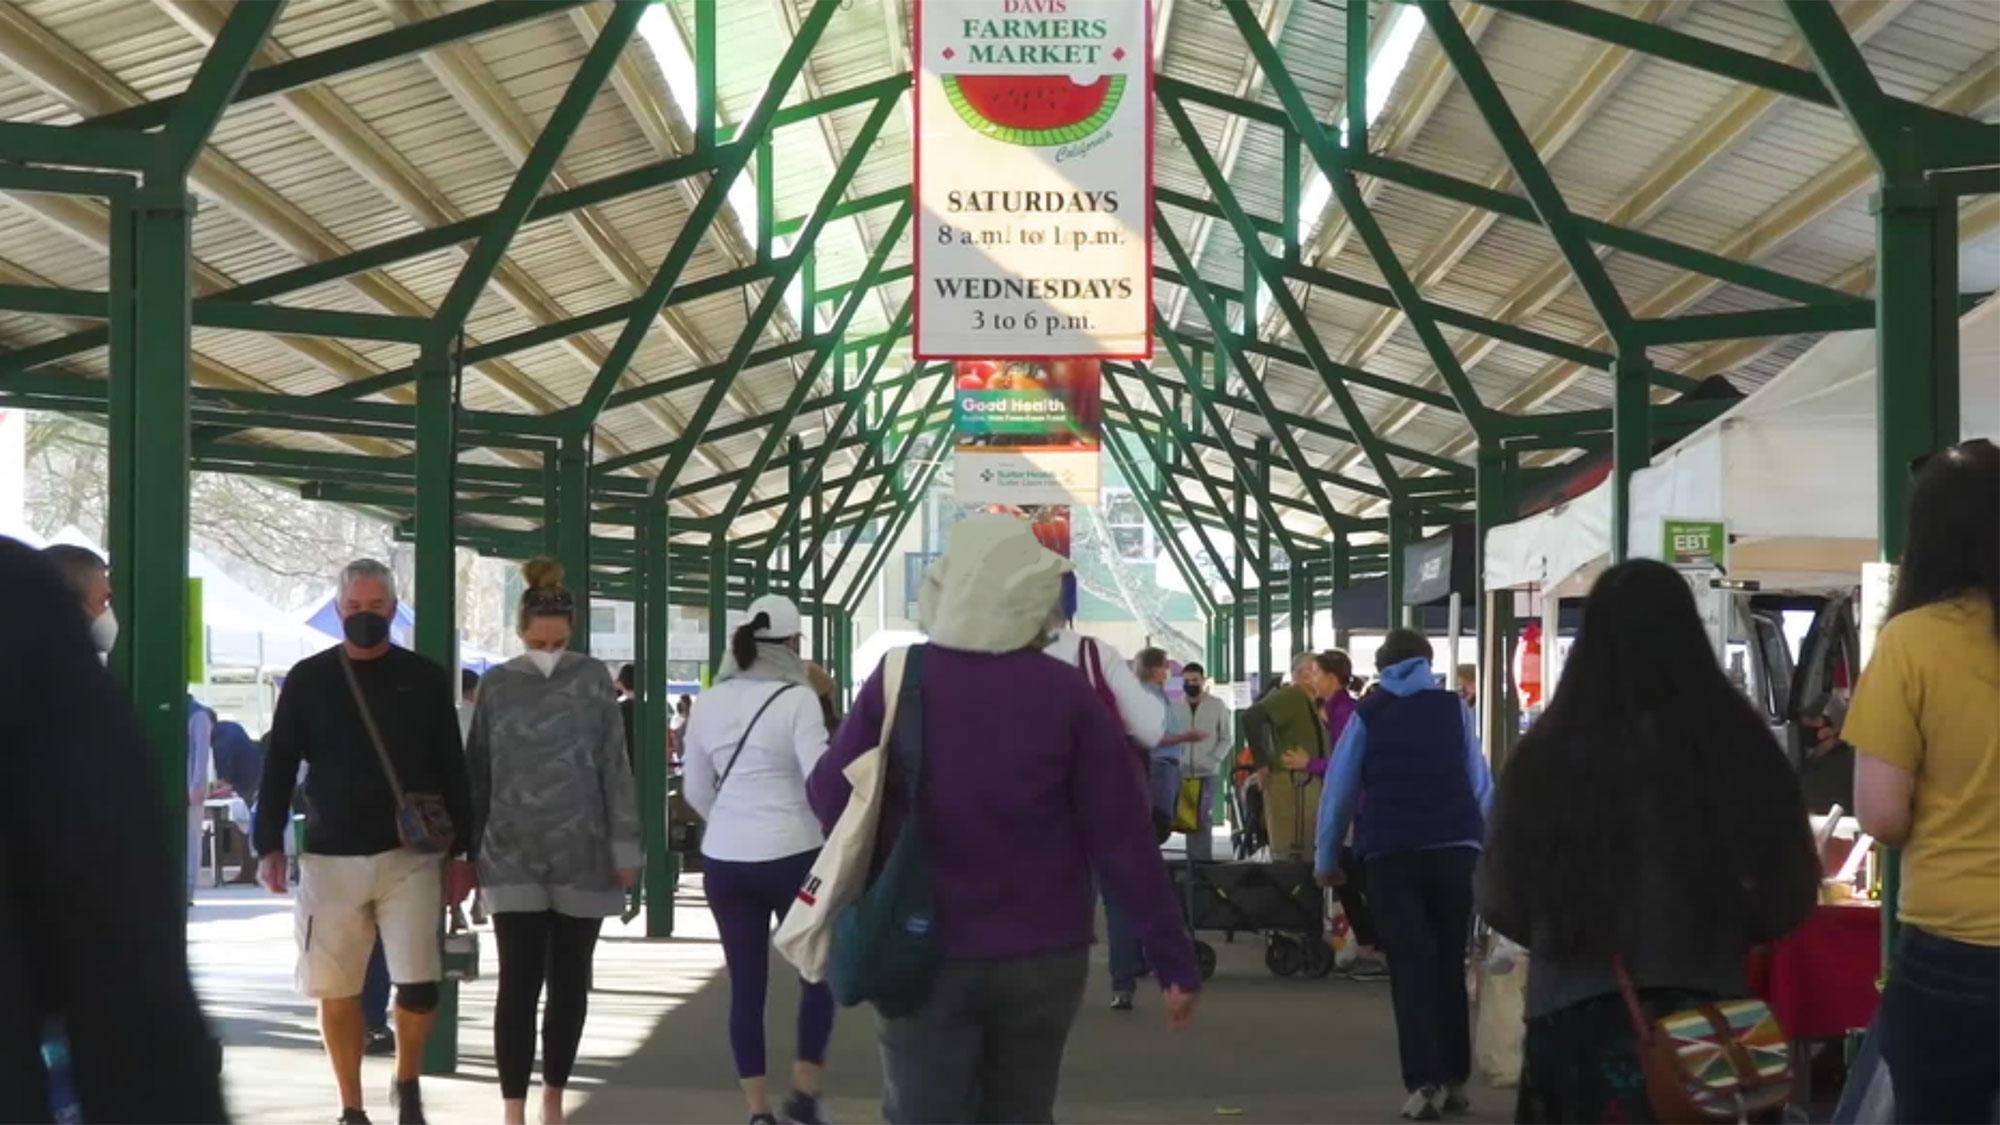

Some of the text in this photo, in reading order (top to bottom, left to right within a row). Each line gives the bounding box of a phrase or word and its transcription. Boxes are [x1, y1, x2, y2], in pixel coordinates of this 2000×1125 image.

[1004, 0, 1067, 13] DAVIS
[963, 19, 1107, 39] FARMERS
[969, 45, 1101, 64] MARKET
[948, 191, 1118, 213] SATURDAYS
[938, 225, 953, 245] 8
[1020, 228, 1043, 245] to
[1054, 226, 1062, 244] 1
[1072, 231, 1125, 251] p.m.
[935, 278, 1132, 300] WEDNESDAYS
[971, 310, 1095, 335] 3 to 6 p.m.
[962, 397, 1065, 412] Good Health
[1673, 534, 1712, 551] EBT
